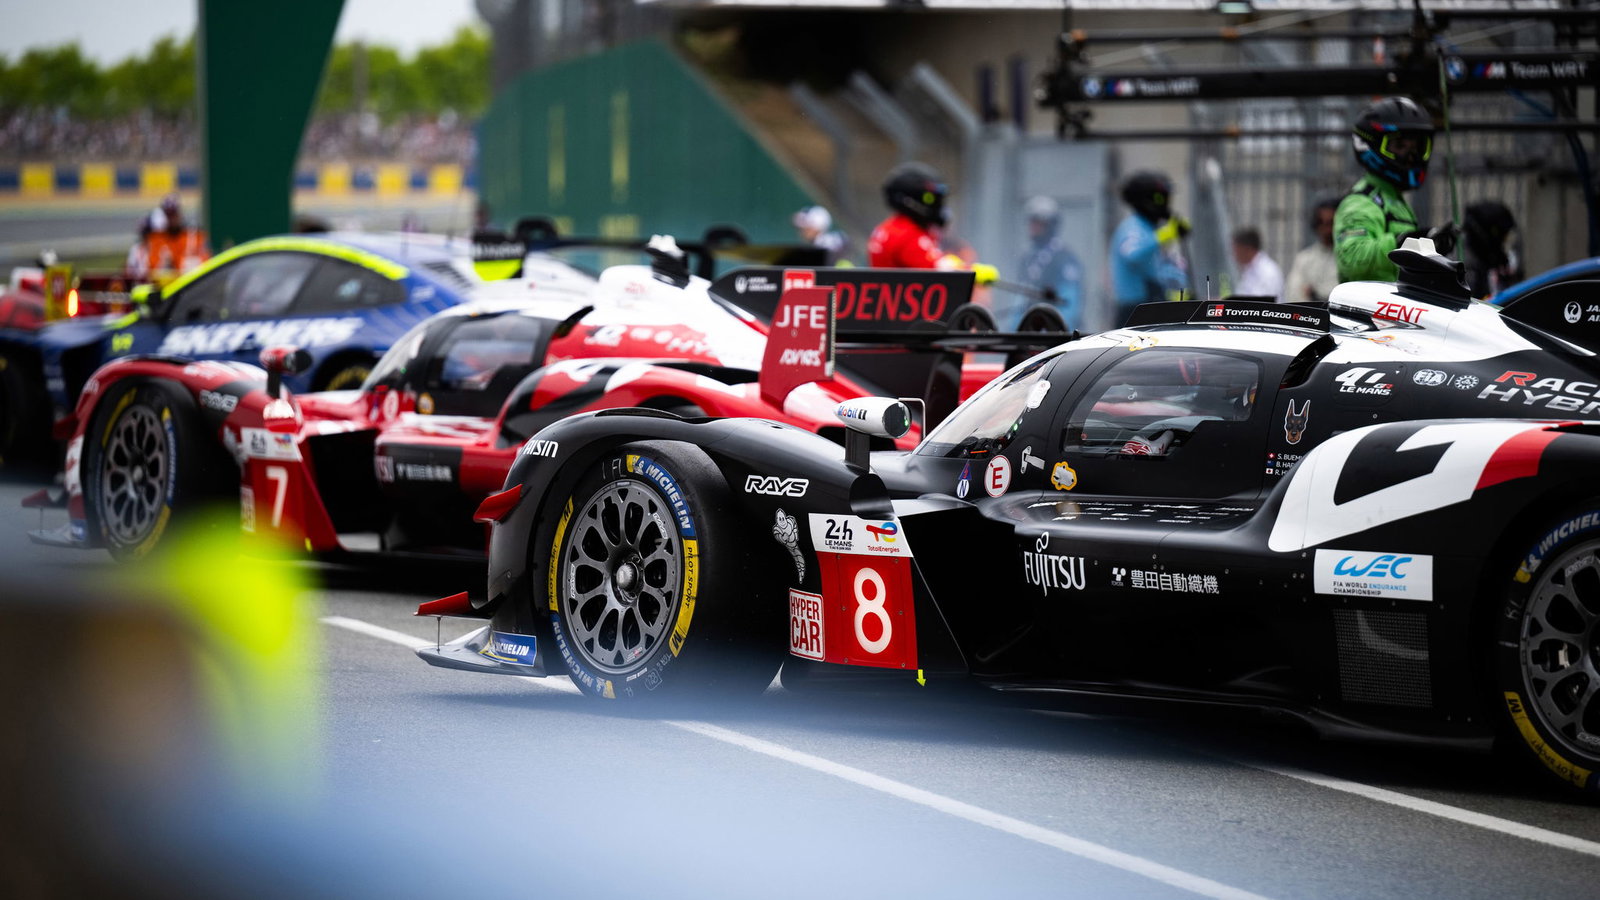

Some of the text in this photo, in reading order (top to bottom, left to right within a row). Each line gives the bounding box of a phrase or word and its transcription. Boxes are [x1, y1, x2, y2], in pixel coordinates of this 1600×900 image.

[1510, 61, 1549, 78] Team
[1552, 61, 1587, 78] WRT
[835, 281, 948, 322] DENSO
[1372, 301, 1429, 324] ZENT
[1585, 304, 1600, 313] JA
[775, 304, 827, 329] JFE
[1207, 308, 1321, 325] GR TOYOTA GAZOO Racing
[1587, 314, 1600, 322] AI
[1356, 387, 1392, 396] MANS
[837, 405, 858, 419] Mobil
[523, 439, 559, 458] AISIN
[744, 474, 810, 498] RAYS
[991, 466, 1004, 490] E
[266, 465, 289, 529] 7
[645, 464, 691, 529] MICHELIN
[825, 518, 853, 541] 24h
[867, 545, 900, 554] TotalEnergies
[1023, 550, 1086, 597] FUJITSU
[1333, 554, 1413, 579] WEC
[1130, 569, 1220, 595] 豊田自動織機
[1333, 588, 1382, 596] CHAMPIONSHIP
[1345, 581, 1368, 589] WORLD
[1368, 583, 1407, 592] ENDURANCE
[790, 595, 820, 621] HYPER
[854, 567, 893, 654] 8
[791, 616, 821, 653] CAR
[552, 620, 593, 689] MICHELIN
